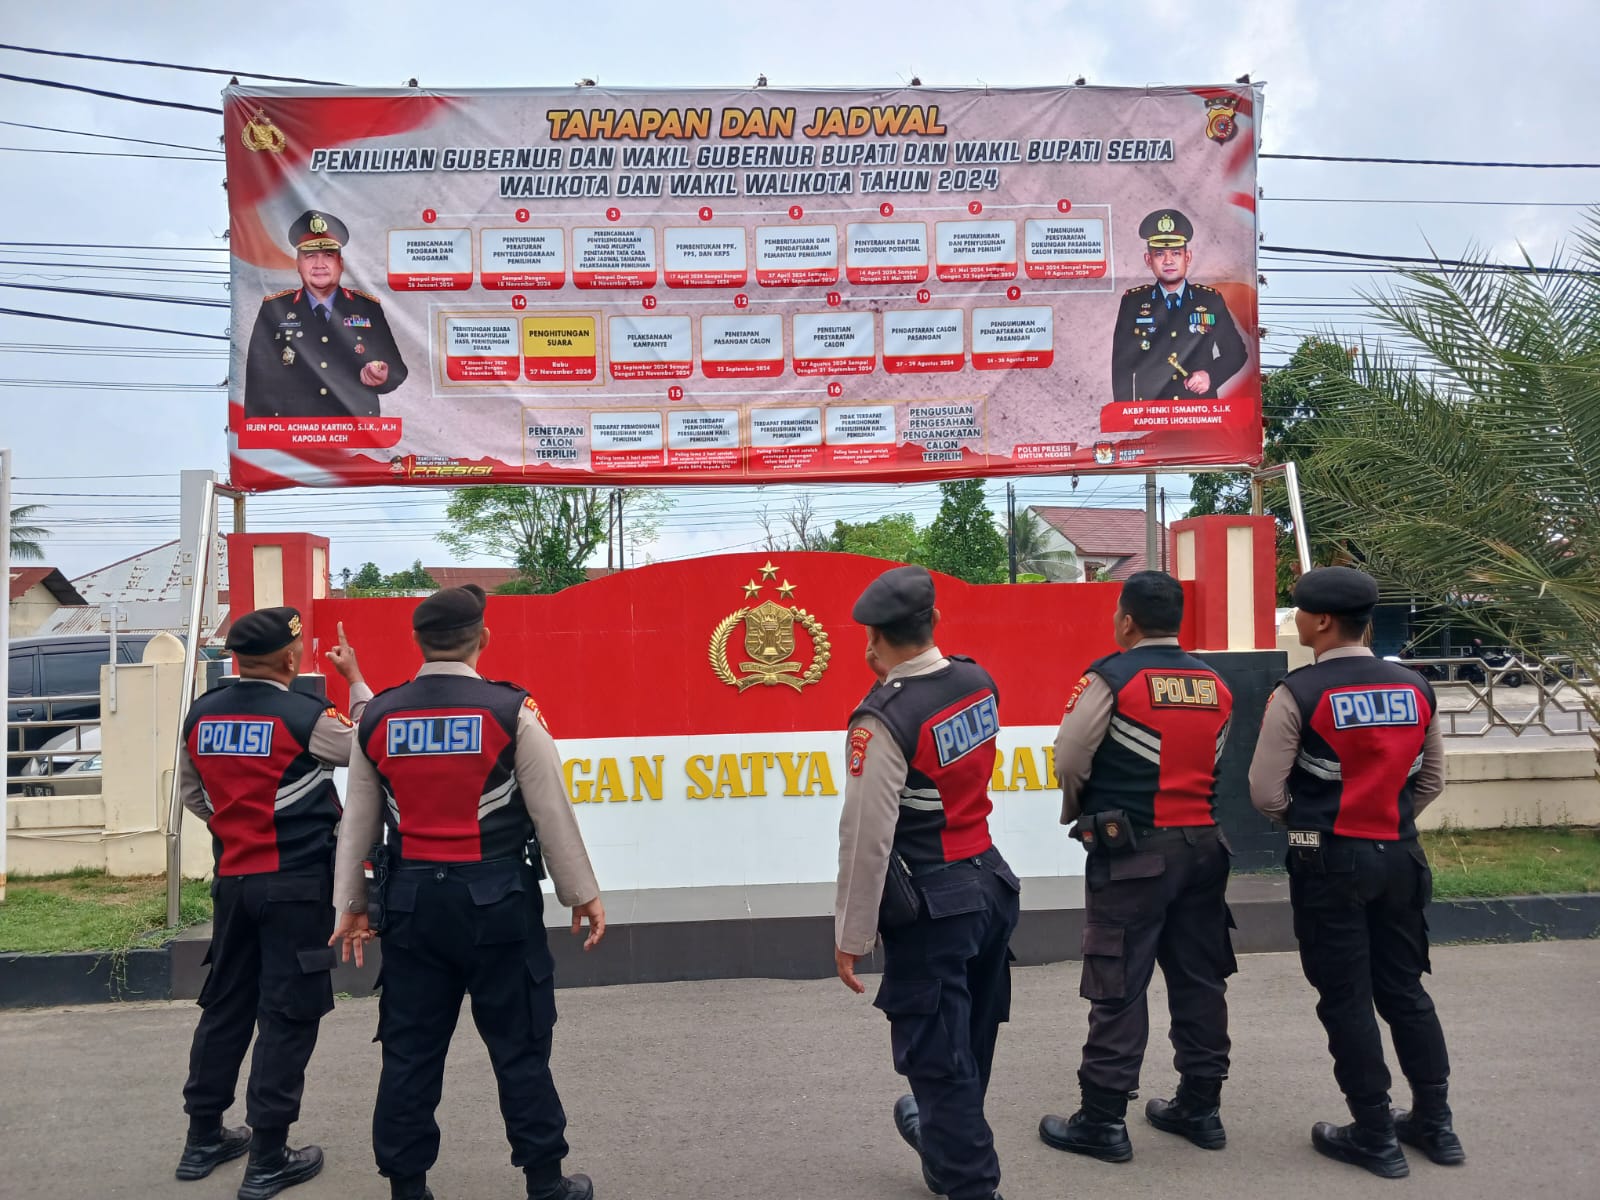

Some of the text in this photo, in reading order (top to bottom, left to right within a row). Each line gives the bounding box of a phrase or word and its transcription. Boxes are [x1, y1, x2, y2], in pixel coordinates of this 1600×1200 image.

[547, 106, 946, 140] TAHAPAN DAN JADWAL
[310, 139, 1173, 171] PEMILIHAN GUBERNUR DAN WAKIL GUBERNUR BUPATI DAN WAKIL BUPATI SERTA
[499, 168, 999, 197] WALIKOTA DAN WAKIL WALIKOTA TAHUN 2024
[514, 298, 524, 306] 14
[910, 407, 972, 416] PENGUSULAN
[1172, 406, 1210, 414] ISMANTO,
[910, 418, 973, 427] PENGESAHAN
[1134, 416, 1222, 425] KAPOLRES LHOKSEUMAWE
[321, 424, 355, 432] KARTIKO,
[529, 427, 584, 435] PENETAPAN
[329, 434, 347, 442] ACEH
[903, 429, 980, 439] PENGANGKATAN
[927, 441, 957, 449] CALON
[536, 450, 576, 458] TERPILIH
[923, 453, 961, 461] TERPILIH
[413, 466, 493, 474] PRESISI
[1152, 677, 1218, 704] POLISI
[1334, 692, 1416, 725] POLISI
[939, 698, 999, 762] POLISI
[202, 724, 271, 753] POLISI
[390, 719, 480, 754] POLISI
[562, 755, 664, 803] GAN
[685, 752, 838, 799] SATYA
[1290, 833, 1317, 844] POLISI
